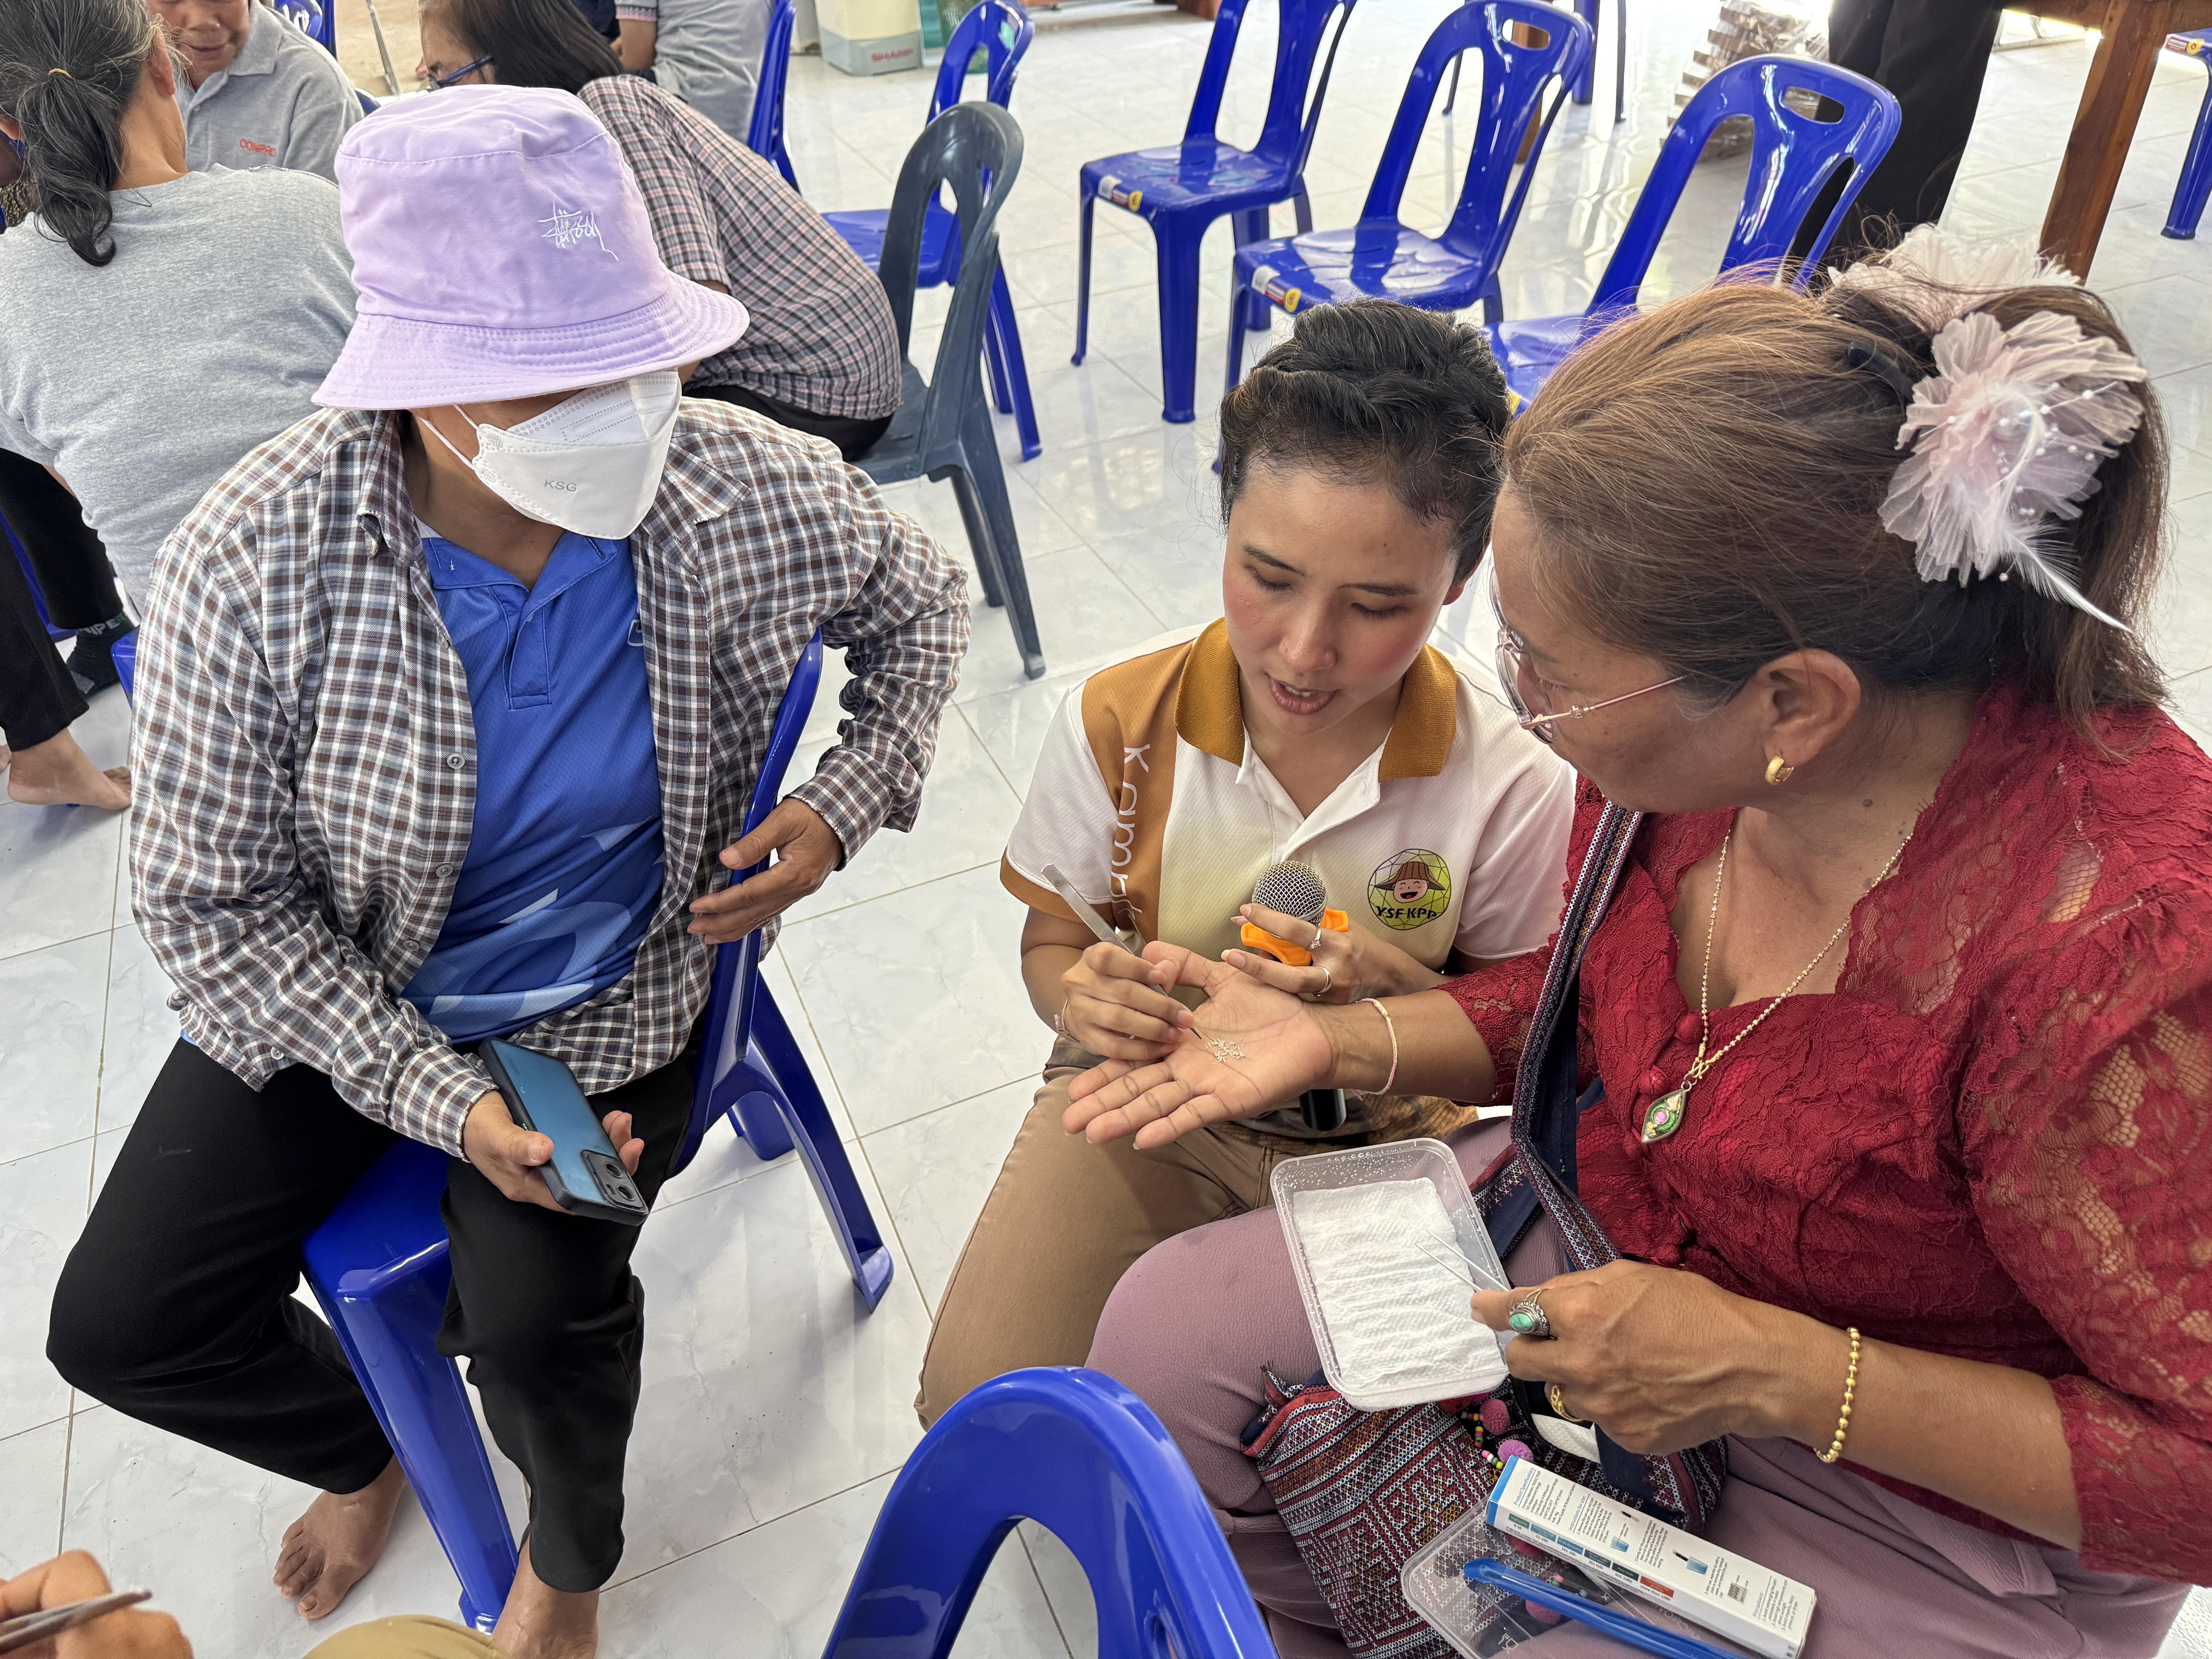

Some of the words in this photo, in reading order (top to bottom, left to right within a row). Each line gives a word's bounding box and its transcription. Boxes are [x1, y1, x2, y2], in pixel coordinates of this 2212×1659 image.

[871, 48, 914, 62] SHARP
[544, 479, 577, 492] KSG
[1376, 905, 1404, 919] YSF
